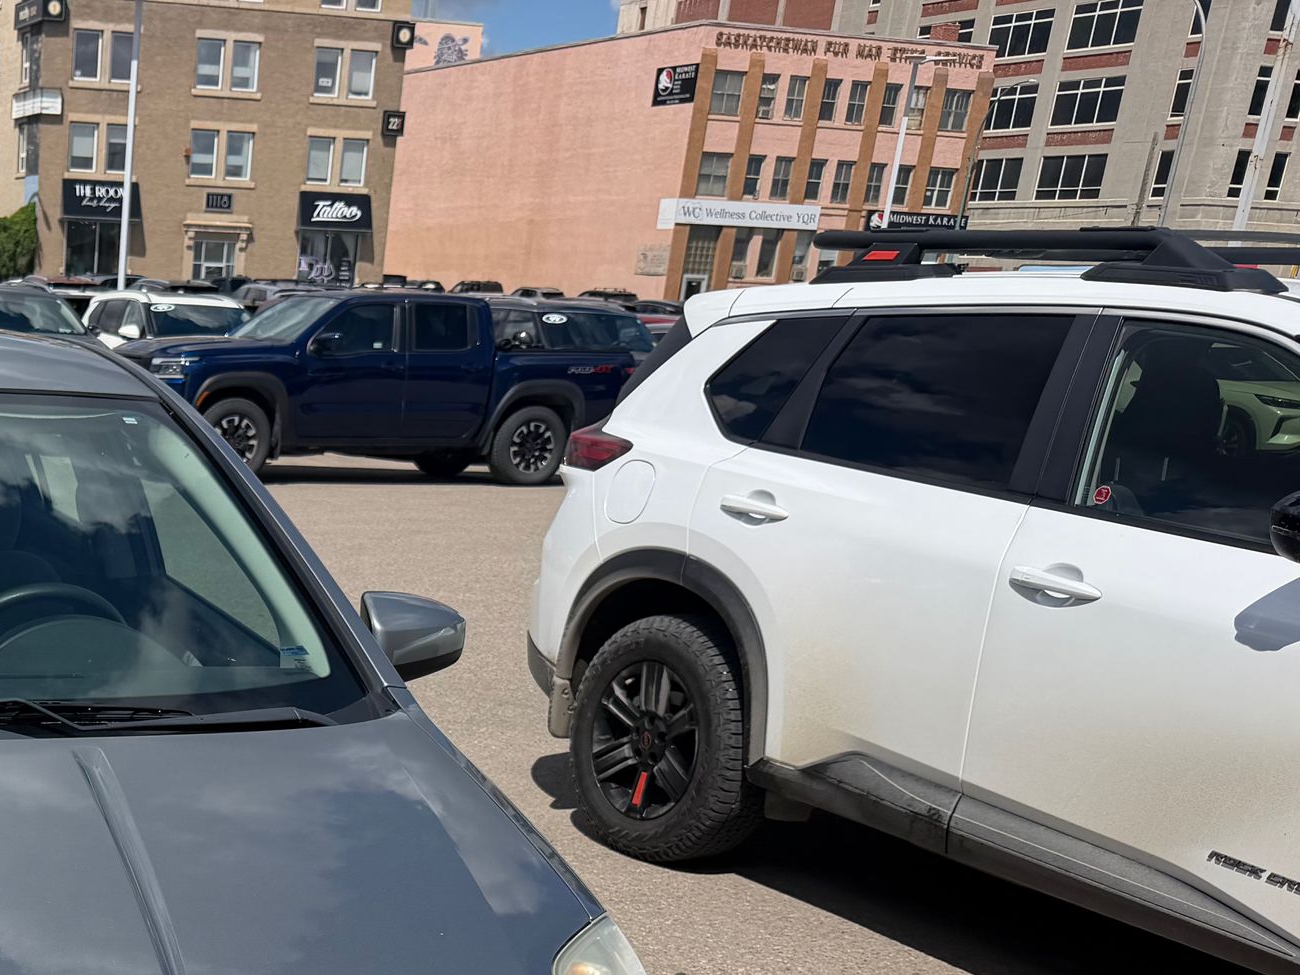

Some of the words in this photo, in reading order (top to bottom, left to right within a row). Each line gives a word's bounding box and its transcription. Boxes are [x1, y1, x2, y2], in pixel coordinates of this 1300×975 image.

[715, 31, 819, 57] SASKATCHEWAN
[824, 40, 850, 59] FUR
[74, 184, 94, 197] THE
[208, 194, 229, 209] 1118
[311, 200, 362, 222] Tattoo
[705, 207, 746, 220] Wellness
[748, 209, 793, 223] Collective
[796, 212, 817, 225] YQR
[889, 213, 926, 225] MIDWEST
[928, 215, 966, 227] KARAE
